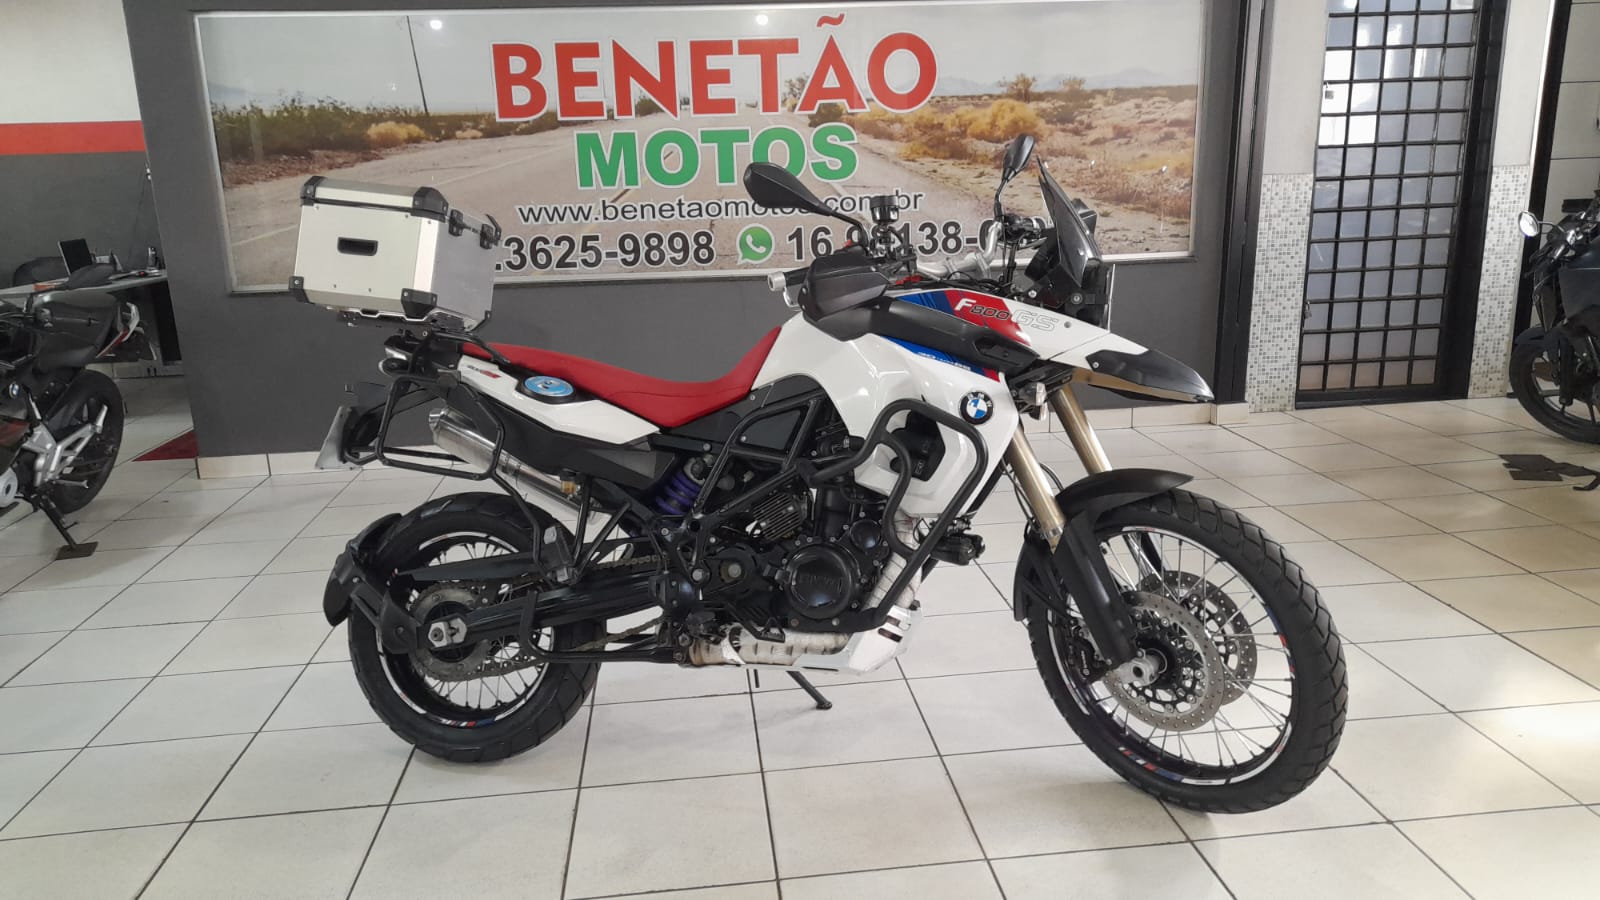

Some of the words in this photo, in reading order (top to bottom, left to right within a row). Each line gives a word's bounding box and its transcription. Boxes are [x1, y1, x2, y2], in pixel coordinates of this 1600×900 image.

[491, 12, 938, 121] BENETÃO
[575, 124, 859, 189] MOTOS
[518, 188, 923, 223] www.benetaomocobr
[966, 391, 994, 409] BMW
